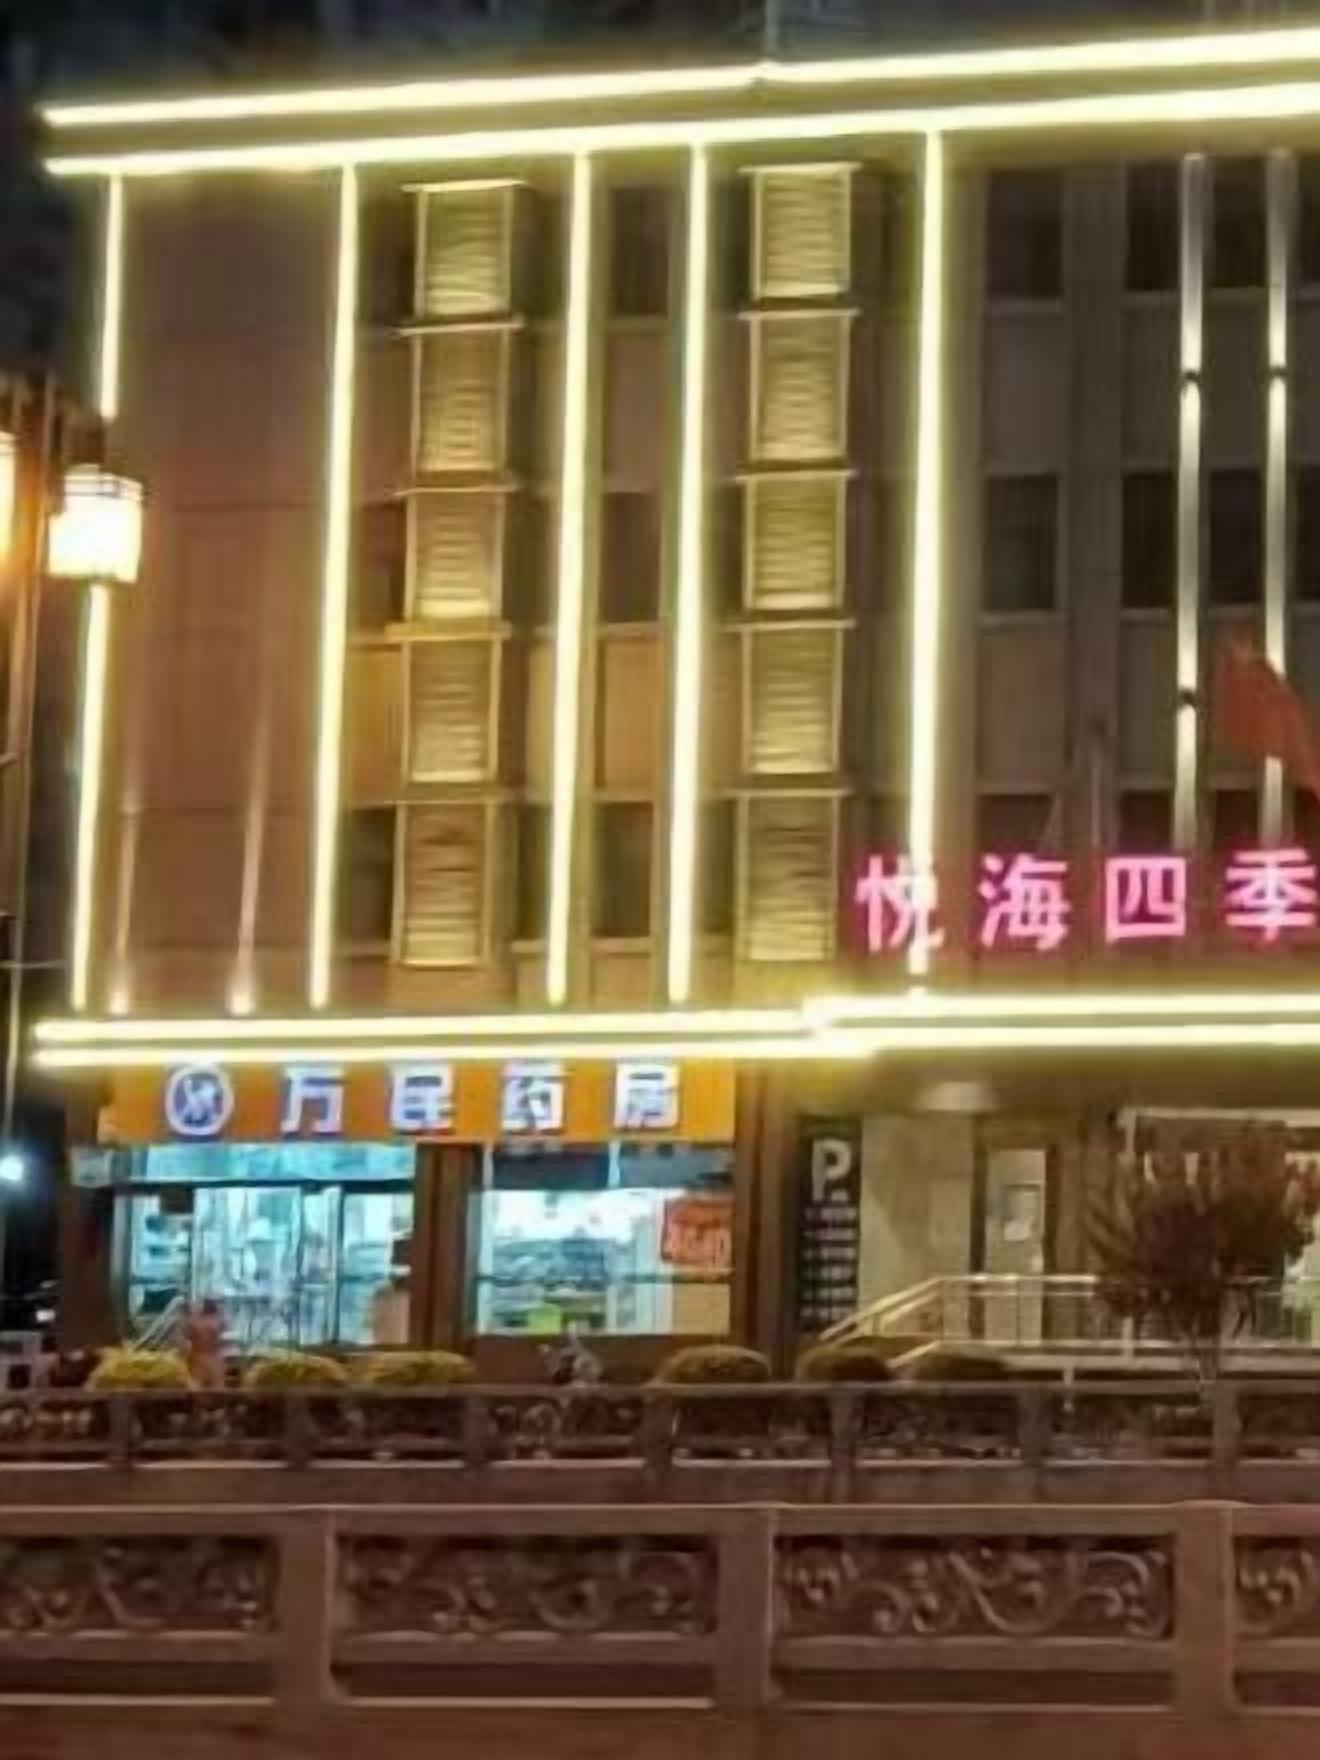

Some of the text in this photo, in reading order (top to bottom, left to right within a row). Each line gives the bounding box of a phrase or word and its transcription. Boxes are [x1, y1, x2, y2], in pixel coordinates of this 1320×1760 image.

[280, 1062, 680, 1132] 万民药房
[811, 1138, 851, 1202] P
